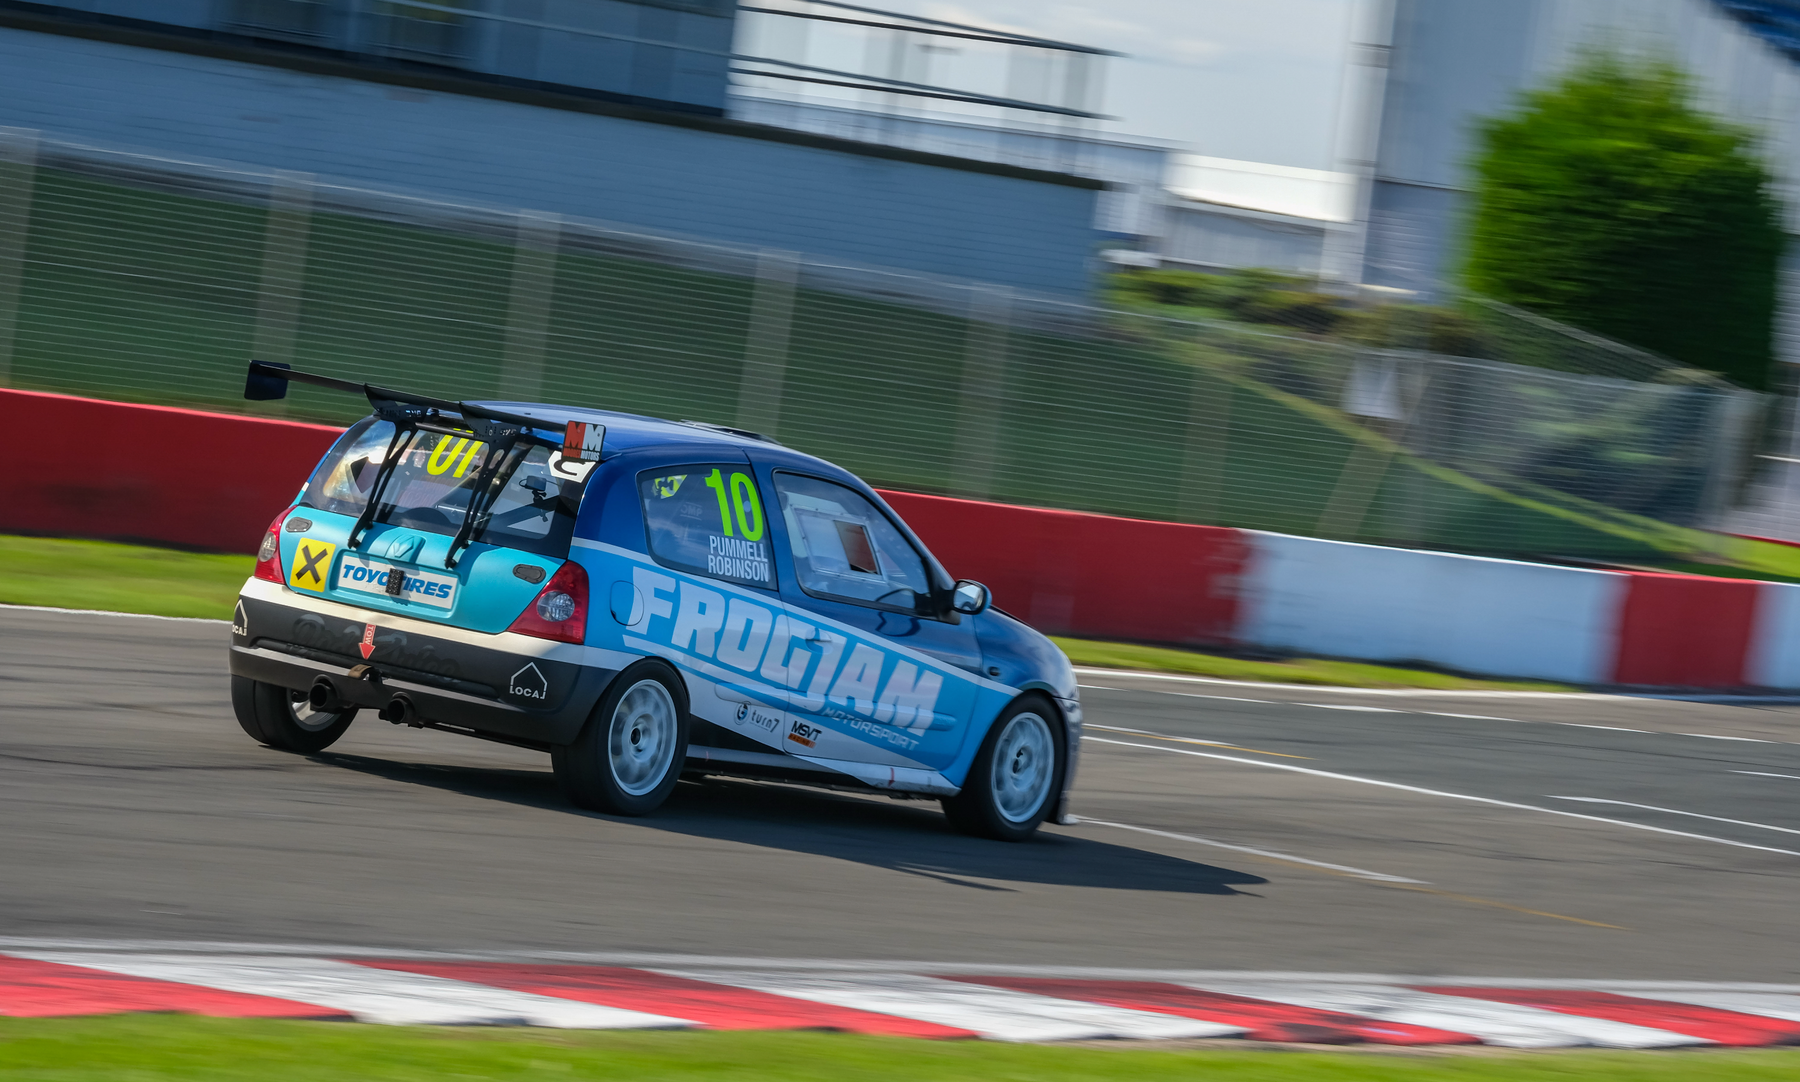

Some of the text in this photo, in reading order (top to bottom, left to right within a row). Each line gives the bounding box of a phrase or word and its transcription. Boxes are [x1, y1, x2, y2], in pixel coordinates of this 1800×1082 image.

[704, 468, 764, 542] 10
[709, 535, 769, 563] PUMMELL
[707, 554, 769, 582] ROBINSON
[403, 575, 452, 599] IRES
[364, 626, 375, 646] TOW
[626, 566, 943, 737] FROGJAM
[509, 685, 547, 700] LOCAL
[751, 709, 780, 733] turn7
[791, 720, 823, 741] MSVT
[822, 707, 919, 751] MOTORSPORT
